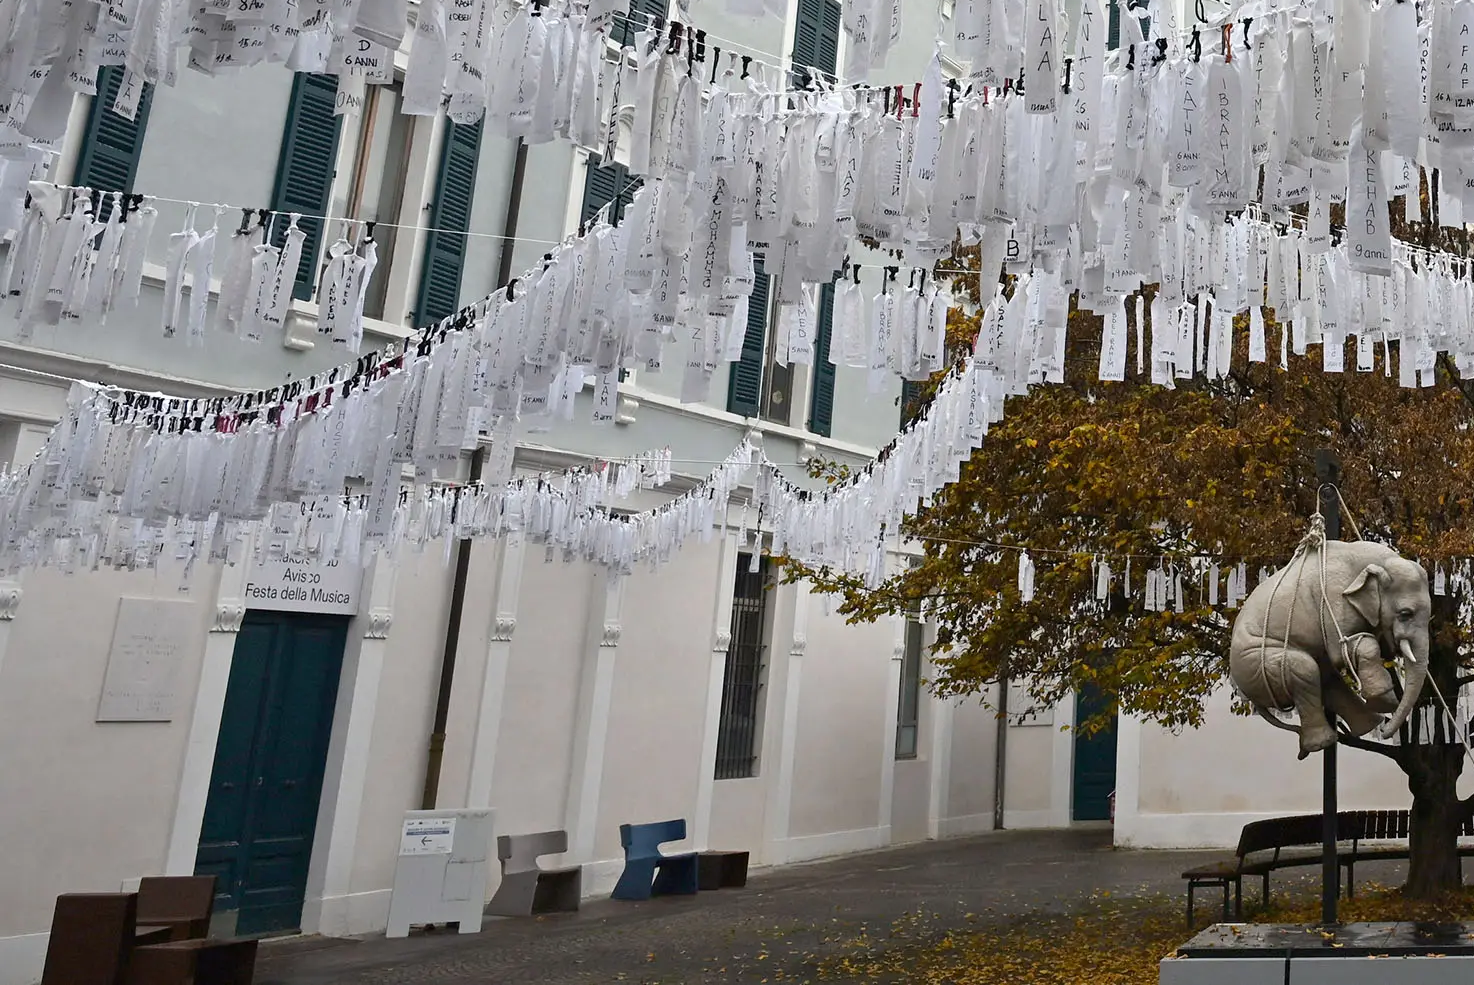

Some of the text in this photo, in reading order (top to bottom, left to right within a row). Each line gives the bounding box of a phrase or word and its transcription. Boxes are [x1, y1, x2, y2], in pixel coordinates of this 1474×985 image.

[344, 56, 379, 69] 6 ANNI
[1460, 22, 1471, 91] AFAF
[1253, 40, 1265, 128] FATIMA
[1215, 76, 1232, 185] IBRAHIM
[245, 583, 350, 605] Festa della Musica
[282, 567, 320, 584] Avisco
